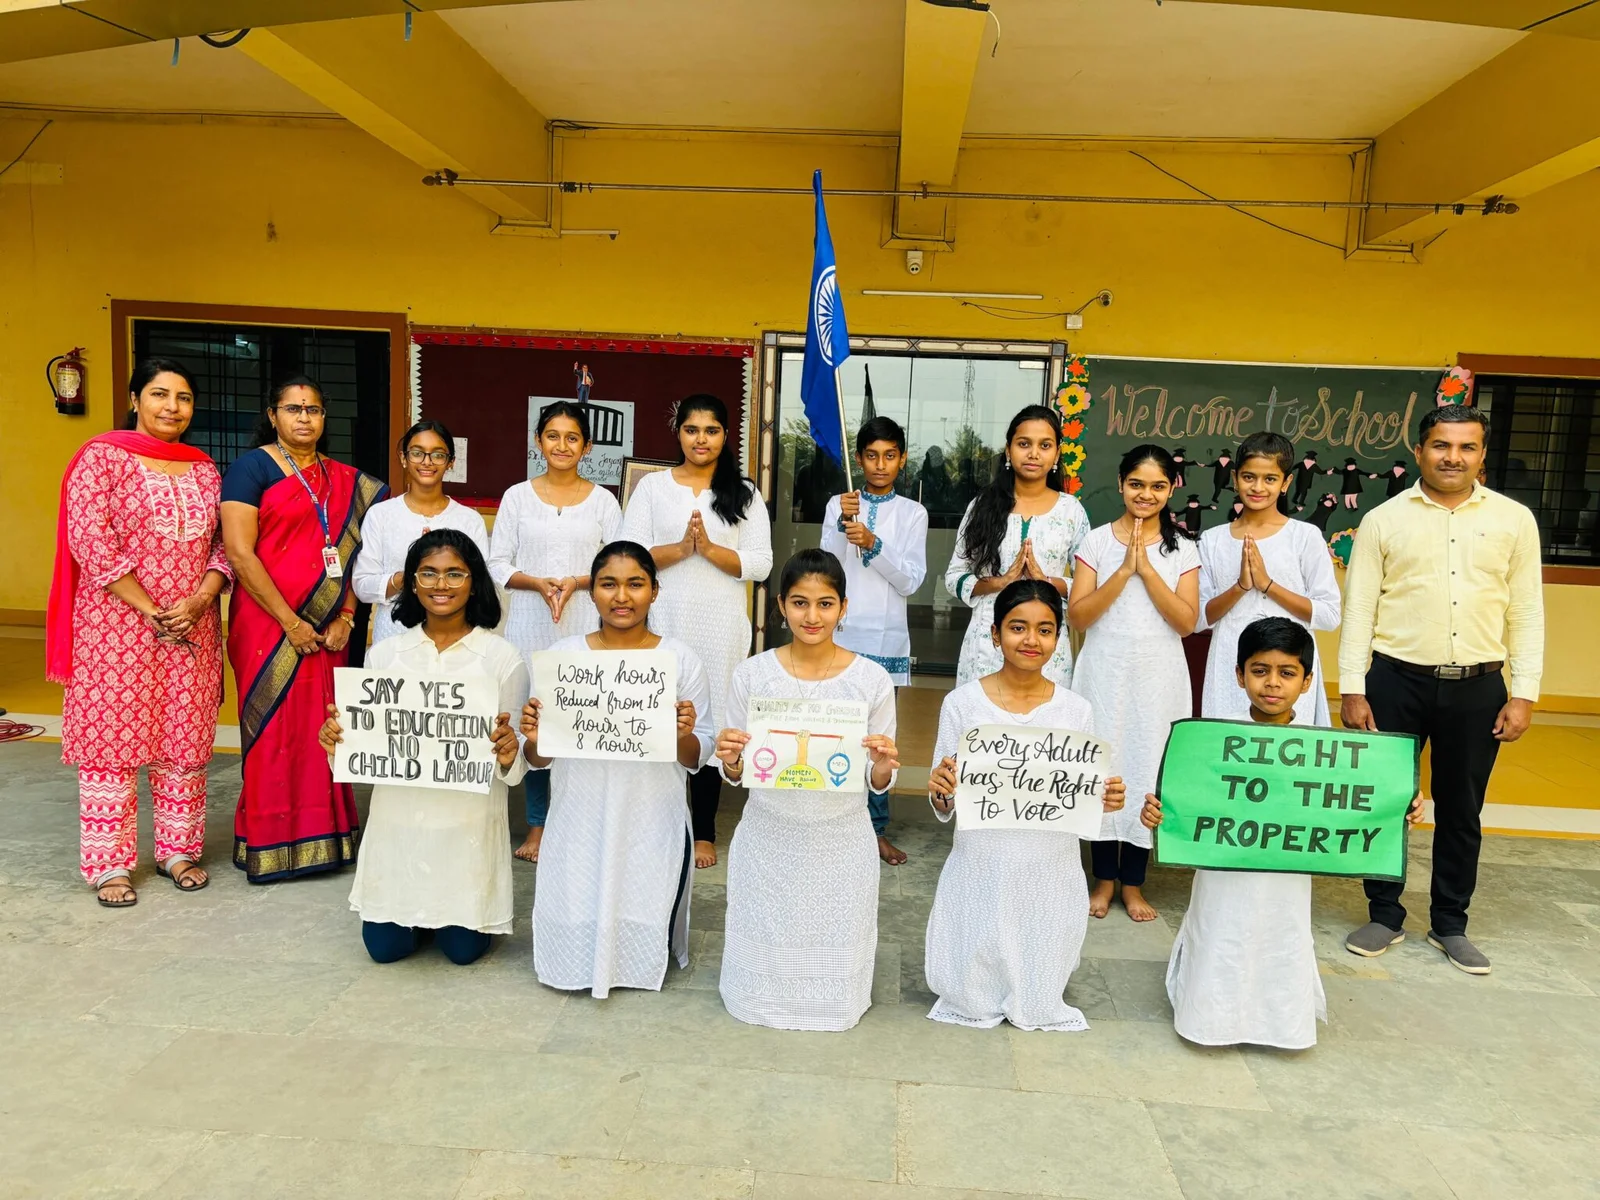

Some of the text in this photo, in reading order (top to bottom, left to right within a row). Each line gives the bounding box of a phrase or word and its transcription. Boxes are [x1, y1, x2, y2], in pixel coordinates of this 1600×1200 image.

[1101, 384, 1418, 460] Welcome to School
[359, 678, 466, 710] SAY YES
[557, 660, 666, 695] Work hours
[554, 687, 659, 715] Reduced from 16
[346, 705, 493, 739] TO EDUCATION
[572, 710, 652, 737] hours to
[388, 735, 469, 762] NO TO
[576, 732, 649, 757] 8 hours
[966, 728, 1102, 770] Every Adult
[1222, 735, 1369, 769] RIGHT
[348, 752, 493, 788] CHILD LABOUR
[960, 761, 1101, 809] has the Right
[974, 796, 1065, 821] to Vote
[1221, 775, 1375, 812] TO THE
[1193, 816, 1382, 854] PROPERTY
